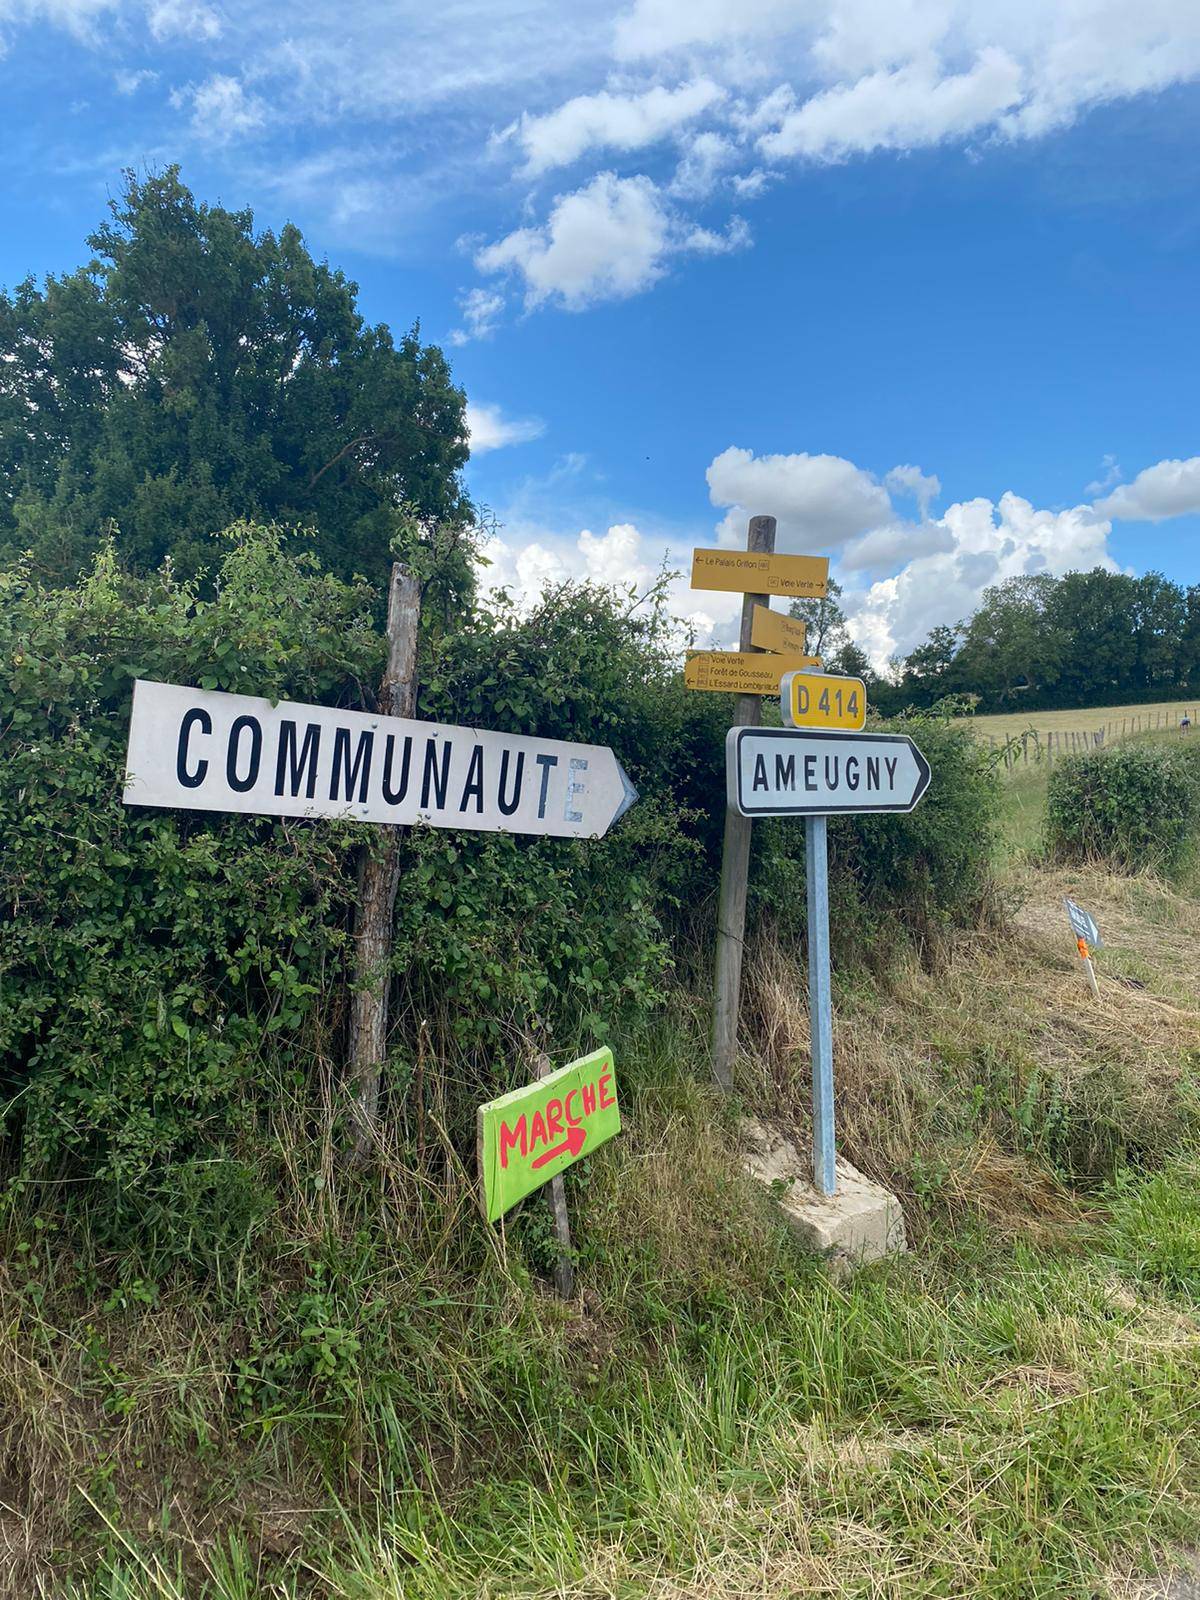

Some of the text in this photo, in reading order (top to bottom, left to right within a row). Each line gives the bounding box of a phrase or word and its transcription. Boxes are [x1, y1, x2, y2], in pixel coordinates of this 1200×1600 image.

[705, 557, 714, 566] Le
[715, 558, 735, 567] Palais
[737, 559, 757, 569] Grillon
[780, 578, 795, 588] Voie
[796, 579, 814, 589] Verte
[710, 666, 728, 676] Forêt
[729, 669, 737, 677] de
[711, 655, 726, 664] Voie
[727, 656, 745, 665] Verte
[797, 685, 859, 719] D 414
[176, 707, 589, 823] COMMUNAUTE
[752, 753, 898, 792] AMEUGNY
[499, 1062, 617, 1169] MARCHÉ
